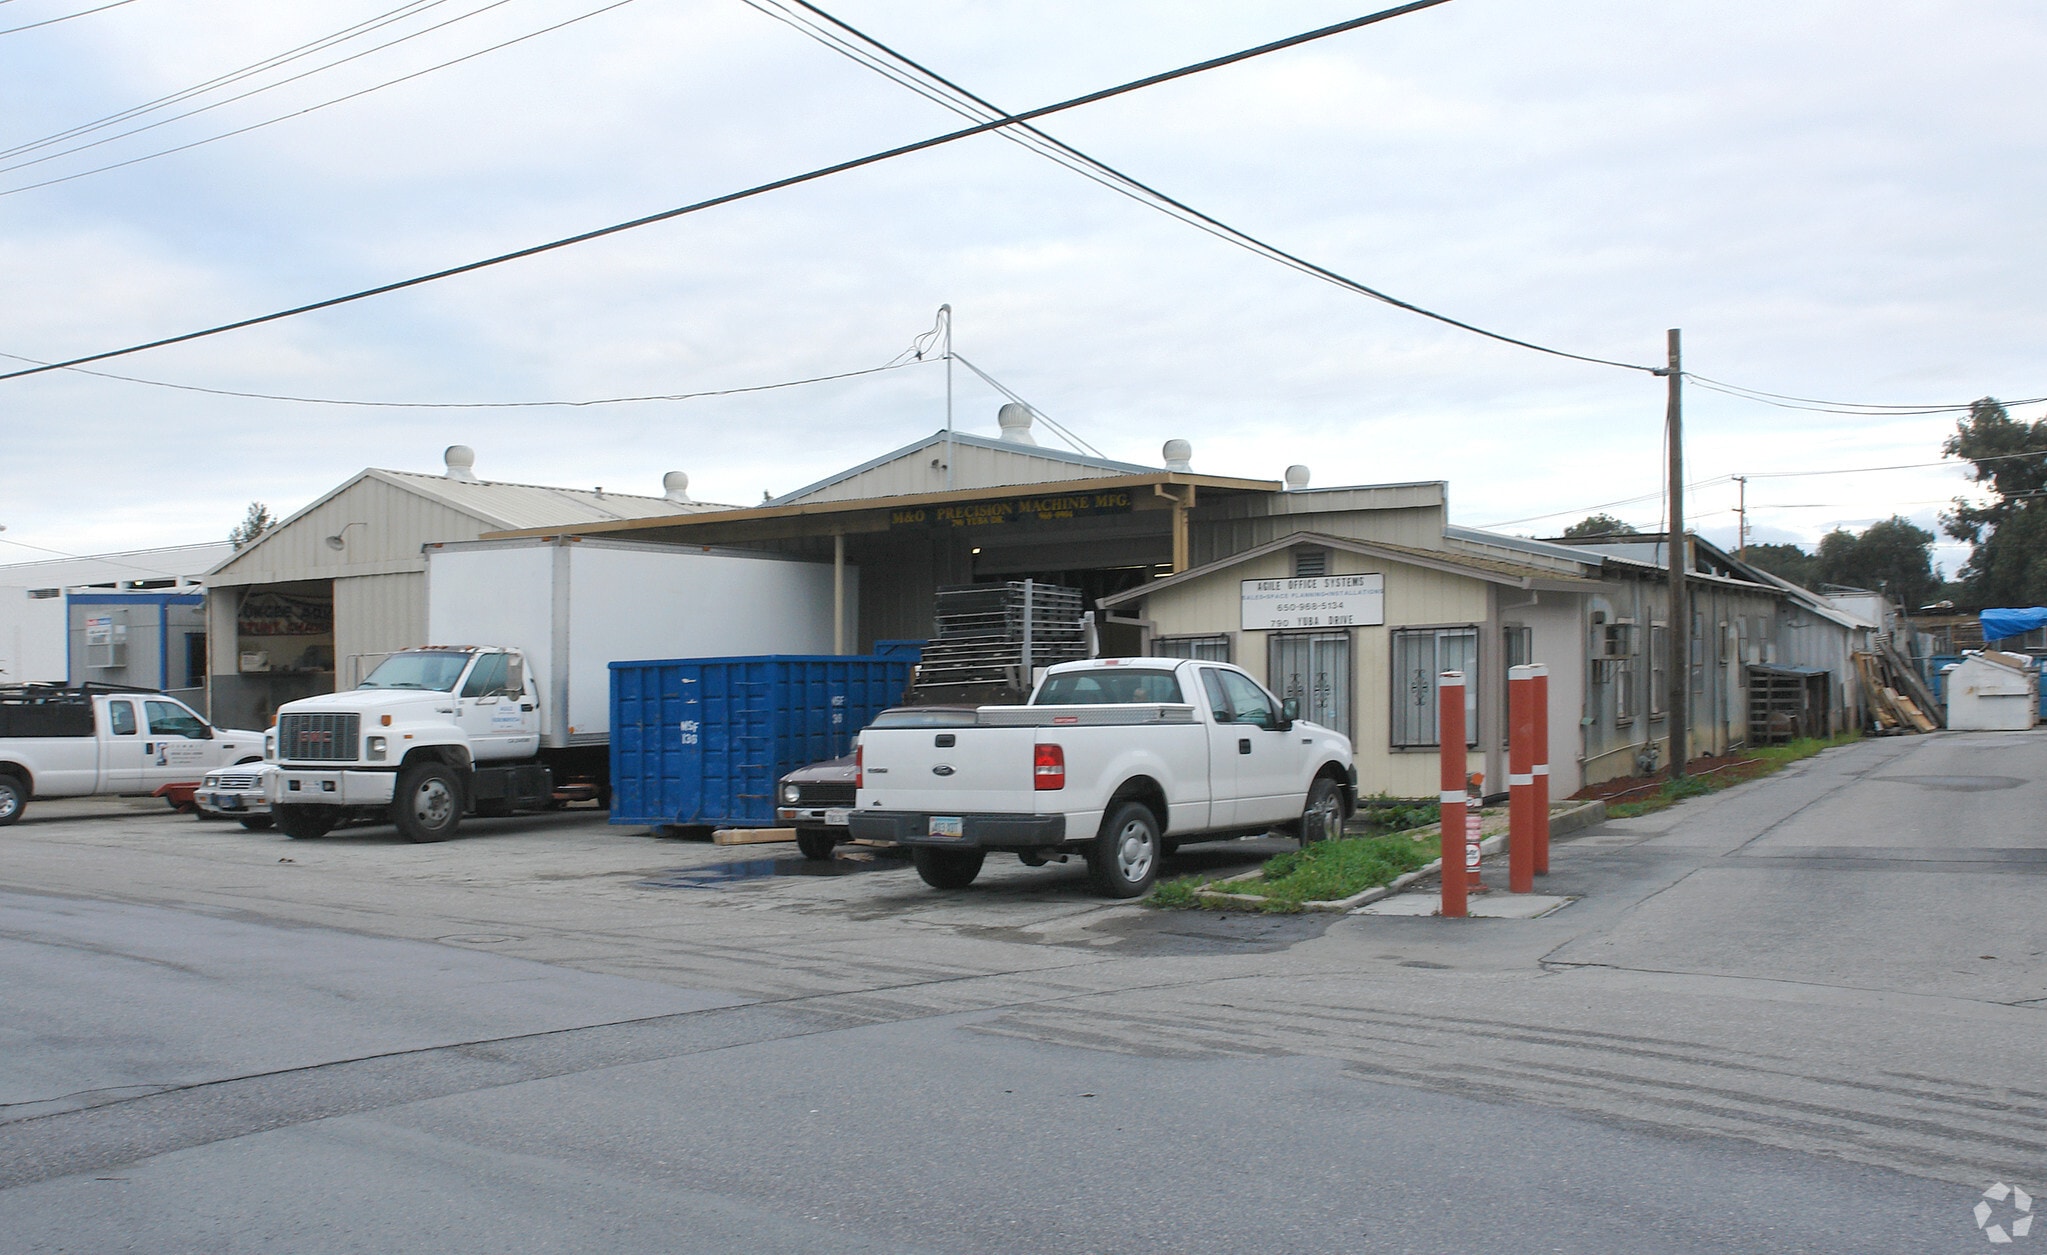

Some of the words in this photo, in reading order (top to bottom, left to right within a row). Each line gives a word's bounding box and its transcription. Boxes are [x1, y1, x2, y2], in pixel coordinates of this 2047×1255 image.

[893, 510, 926, 524] M&O
[936, 503, 1012, 520] PRECISION
[1019, 497, 1089, 513] MACHINE
[1095, 493, 1131, 508] MFG.
[1257, 581, 1281, 591] AGILE
[1288, 579, 1317, 590] OFFICE
[1324, 576, 1365, 588] SYSTEMS
[1270, 619, 1289, 628] 790
[1297, 616, 1319, 627] YUBA
[1328, 614, 1354, 625] DRIVE
